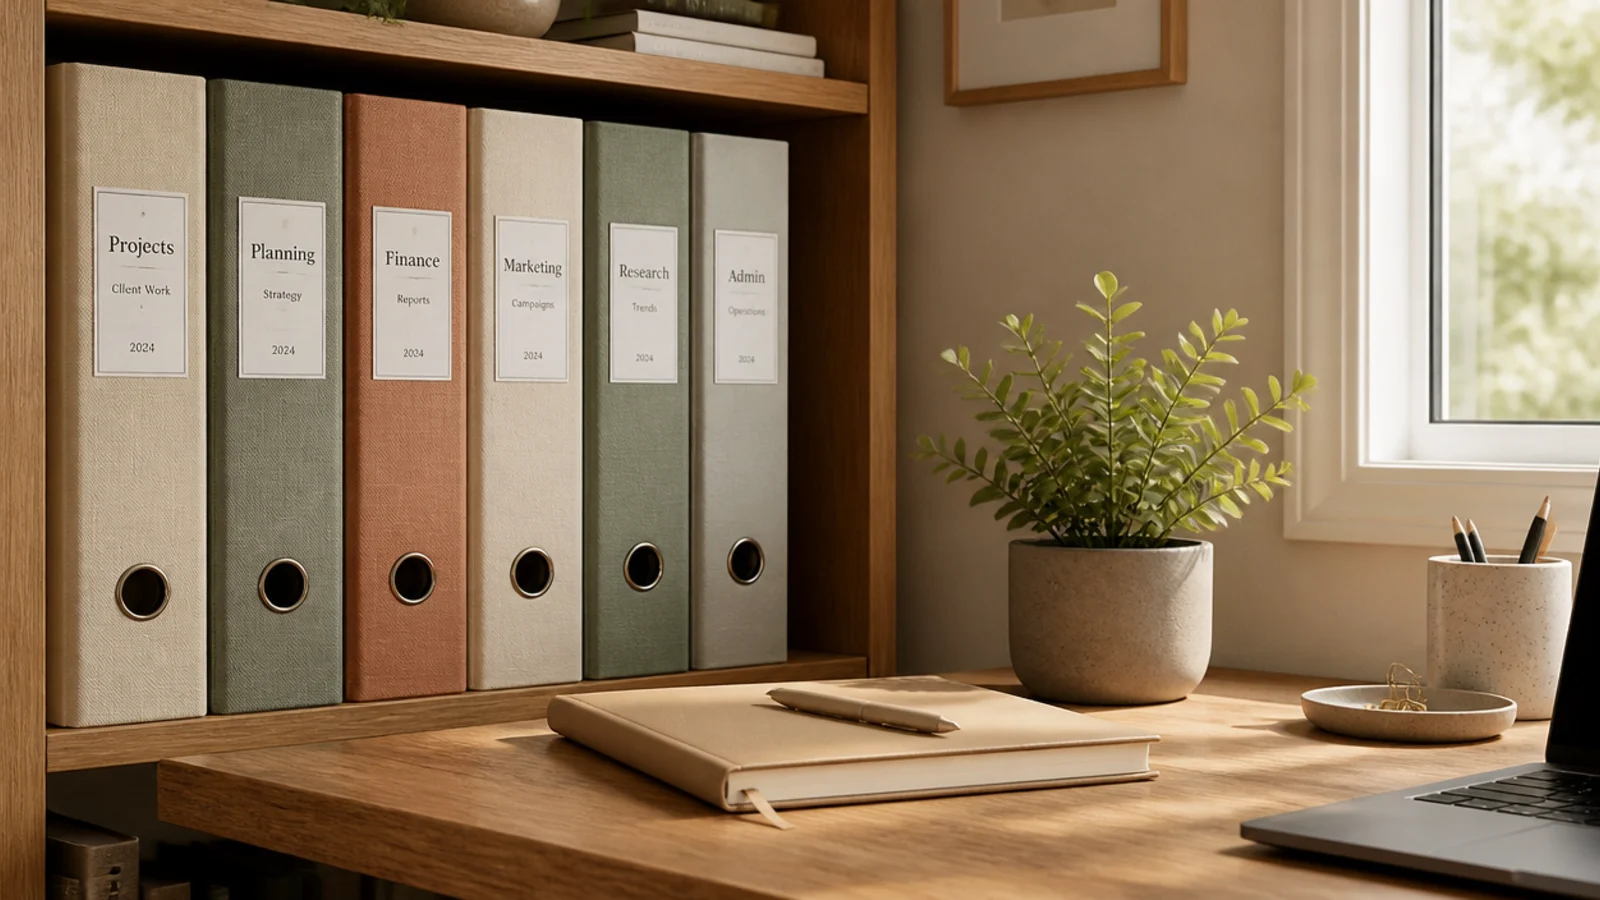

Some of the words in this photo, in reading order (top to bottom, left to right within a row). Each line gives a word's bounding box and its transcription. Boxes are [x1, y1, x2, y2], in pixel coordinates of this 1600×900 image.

[109, 236, 174, 258] Projects
[251, 243, 315, 265] Planning
[385, 250, 440, 267] Finance
[503, 258, 562, 278] Marketing
[620, 264, 669, 279] Research
[728, 270, 765, 283] Admin
[145, 285, 171, 296] Work
[263, 289, 302, 302] Strategy
[397, 294, 430, 307] Reports
[512, 299, 555, 311] Campaigns
[632, 302, 657, 312] Trends
[130, 342, 154, 353] 2024
[272, 345, 295, 355] 2024
[404, 349, 423, 357] 2024
[524, 351, 542, 360] 2024
[636, 354, 653, 362] 2024
[739, 355, 755, 363] 2024
